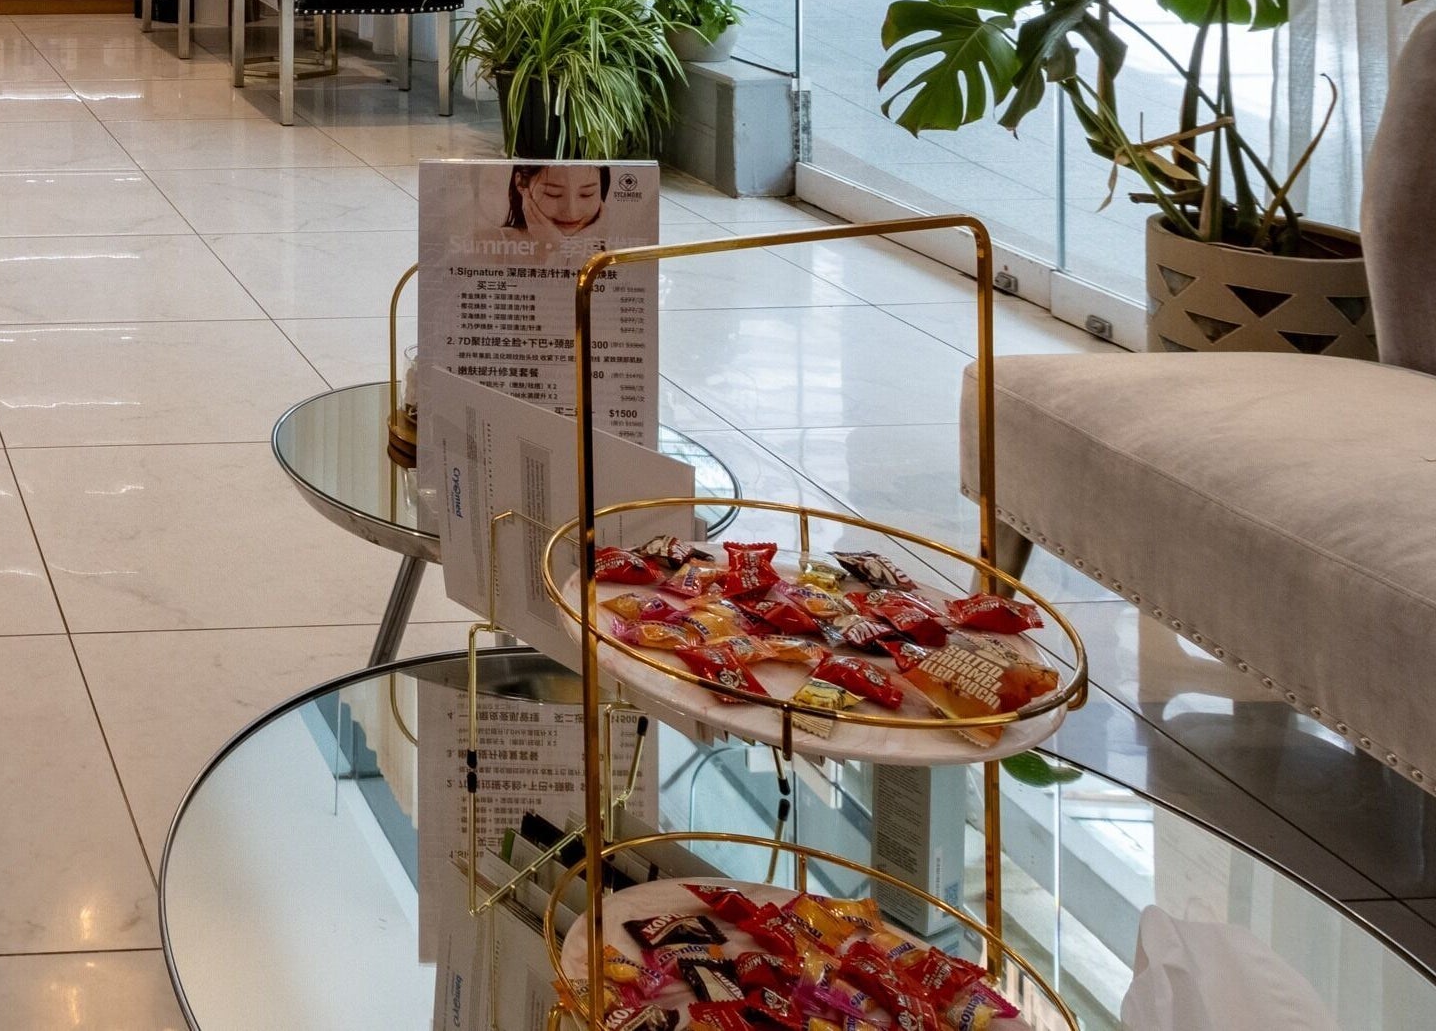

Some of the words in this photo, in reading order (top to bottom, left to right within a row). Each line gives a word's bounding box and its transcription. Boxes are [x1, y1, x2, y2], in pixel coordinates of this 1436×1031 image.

[613, 191, 643, 199] SYCAMORE
[449, 234, 539, 256] Summer
[507, 268, 618, 281] 深层清洁/针清+焕肤
[476, 280, 518, 291] 买三送一
[609, 409, 638, 419] $1500
[945, 644, 1005, 679] SALTED
[927, 651, 1003, 693] CARAMEL
[917, 659, 957, 682] ILLED
[957, 675, 1001, 710] MOCHI
